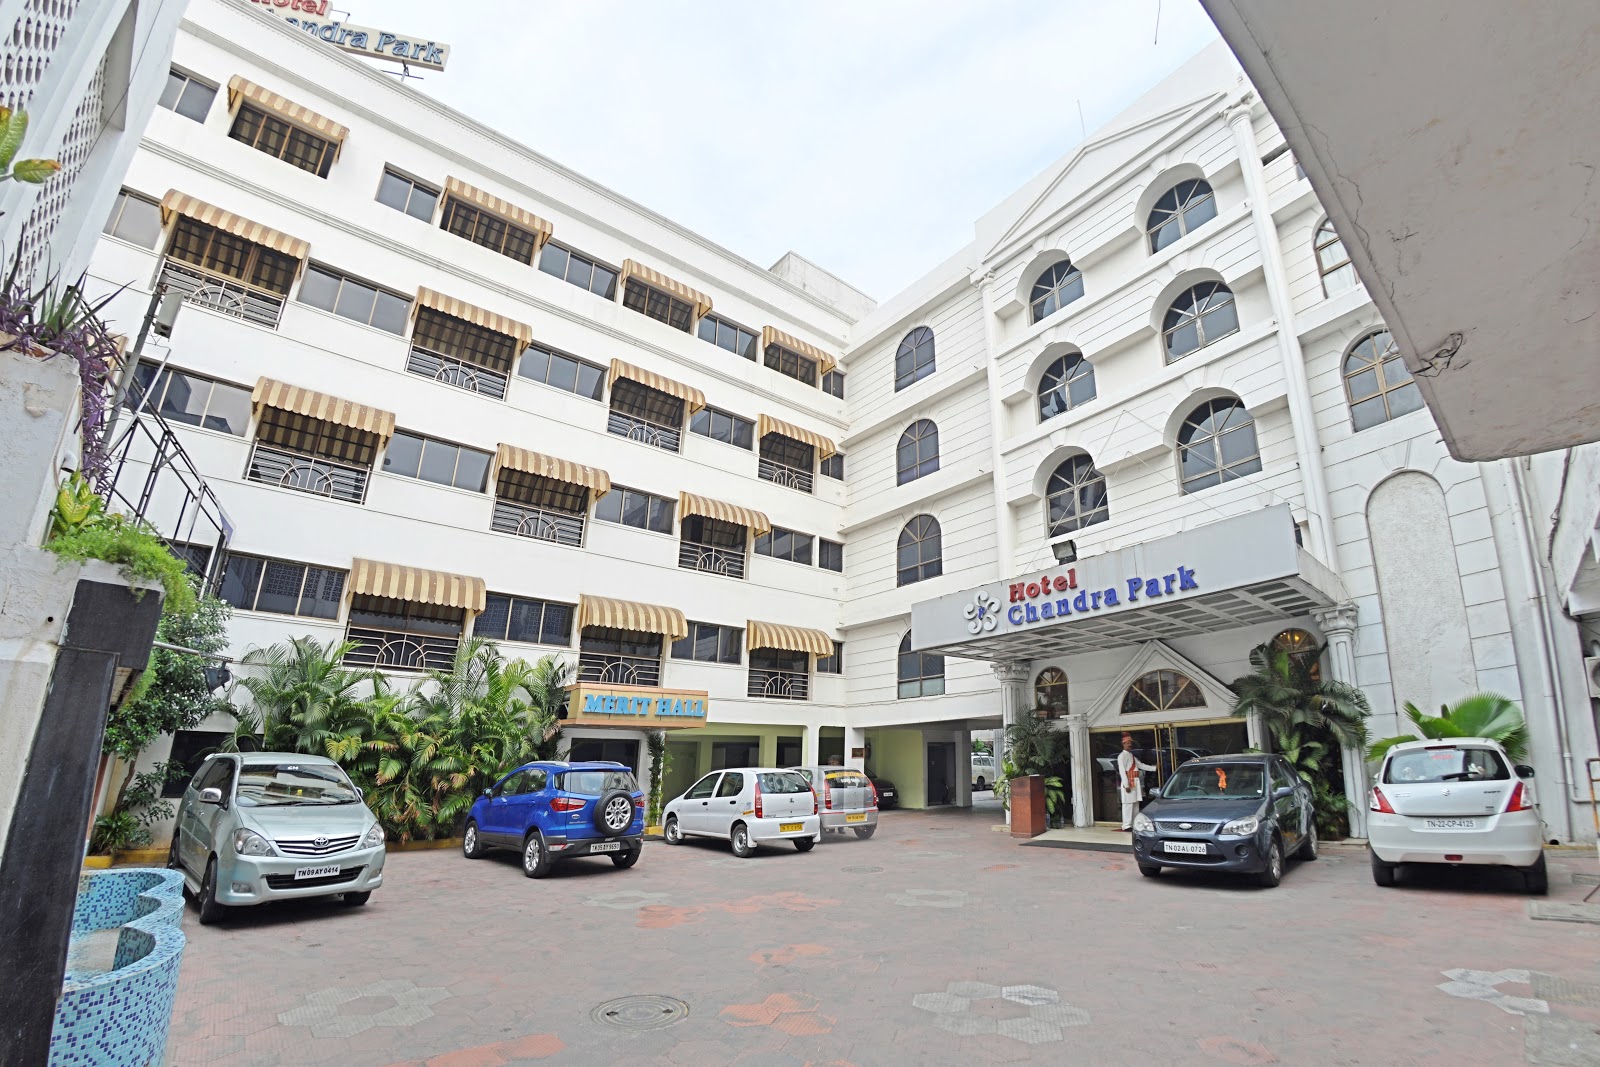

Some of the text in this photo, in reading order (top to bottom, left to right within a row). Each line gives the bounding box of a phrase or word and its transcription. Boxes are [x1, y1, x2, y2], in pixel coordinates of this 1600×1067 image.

[374, 32, 444, 65] Park
[1007, 566, 1198, 625] Chandra Park
[1009, 568, 1077, 603] Hotel
[583, 694, 706, 717] MERIT HALL
